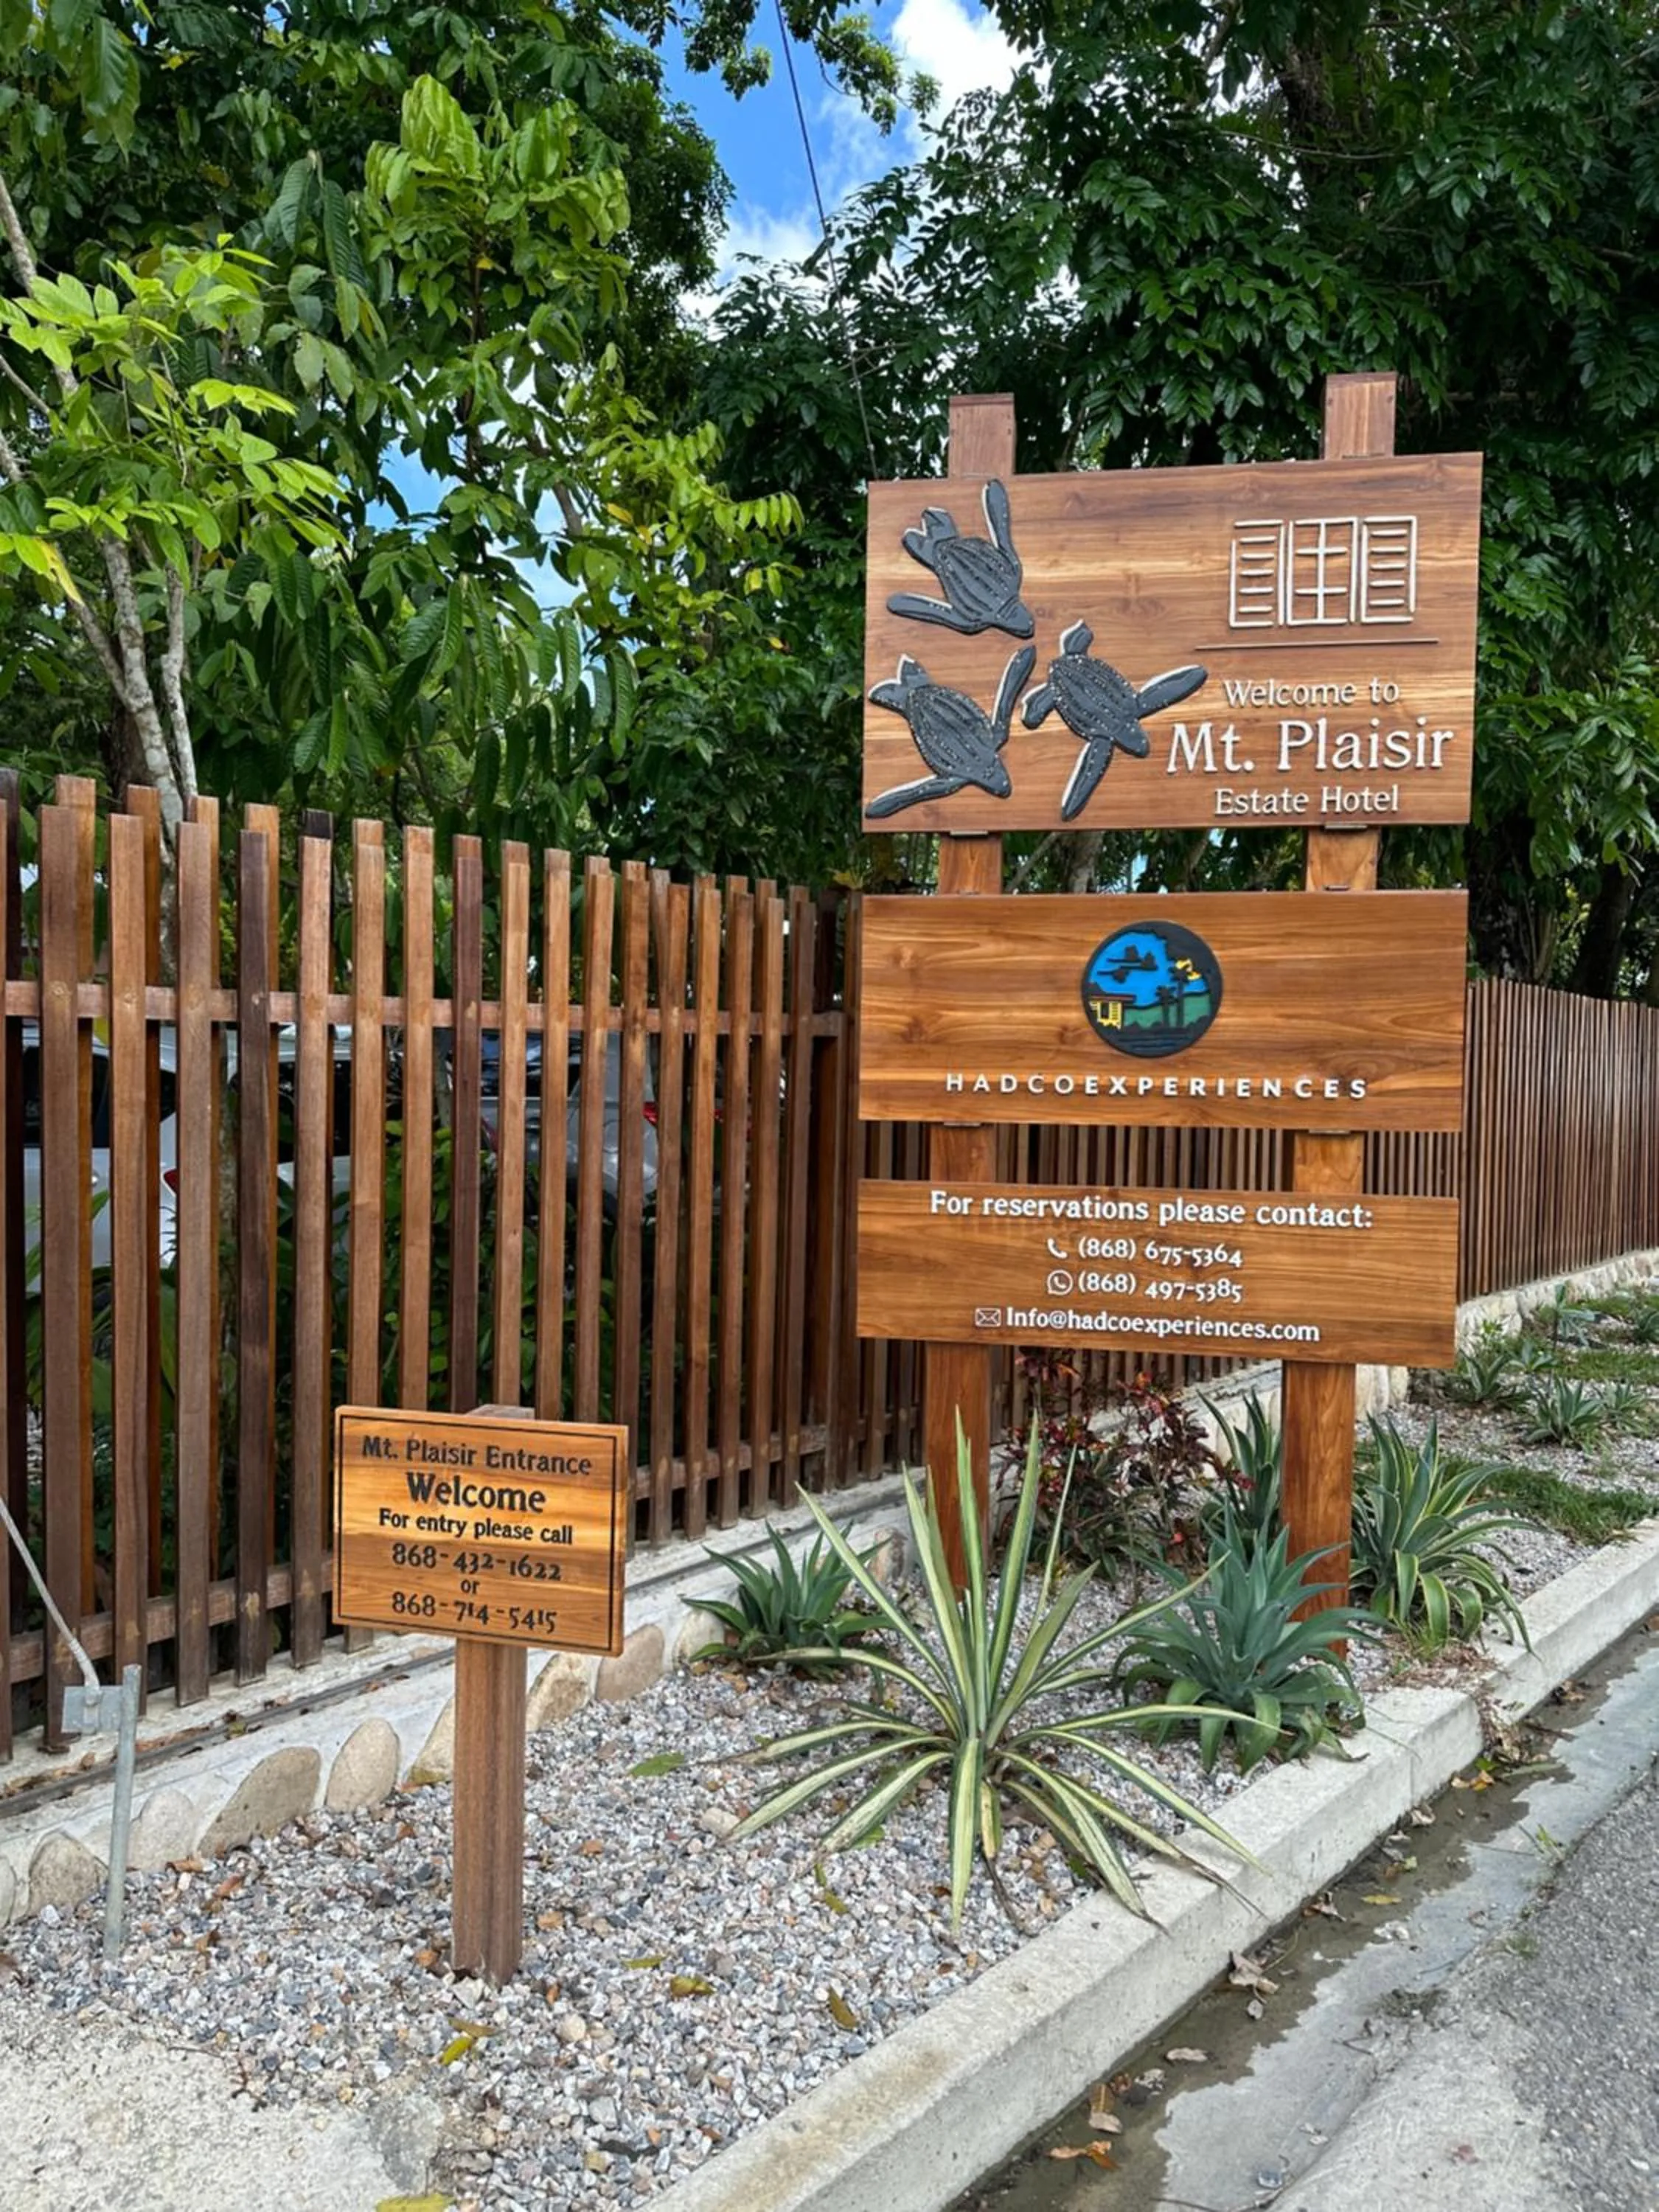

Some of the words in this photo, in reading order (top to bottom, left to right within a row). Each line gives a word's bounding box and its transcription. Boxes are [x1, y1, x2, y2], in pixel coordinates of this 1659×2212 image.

[1224, 678, 1355, 707] Welcome
[1369, 676, 1399, 704] to
[1166, 722, 1254, 773] Mt.
[1277, 717, 1454, 771] Plaisir
[1214, 787, 1309, 815] Estate
[1321, 784, 1399, 813] Hotel
[931, 1190, 973, 1214] For
[981, 1195, 1150, 1221] reservations
[1158, 1198, 1245, 1227] please
[1256, 1203, 1373, 1228] contact:
[1078, 1236, 1136, 1261] (868)
[1144, 1240, 1243, 1268] 675-5364
[1078, 1272, 1136, 1295] (868)
[1144, 1279, 1242, 1304] 497-5385
[1006, 1307, 1321, 1342] Info@hadcoexperiences.com
[362, 1436, 398, 1459] Mt.
[406, 1439, 478, 1466] Plaisir
[485, 1445, 592, 1475] Entrance
[406, 1472, 546, 1513] Welcome
[379, 1508, 410, 1528] For
[416, 1514, 467, 1538] entry
[473, 1517, 533, 1541] please
[540, 1526, 573, 1545] call
[460, 1579, 479, 1594] or
